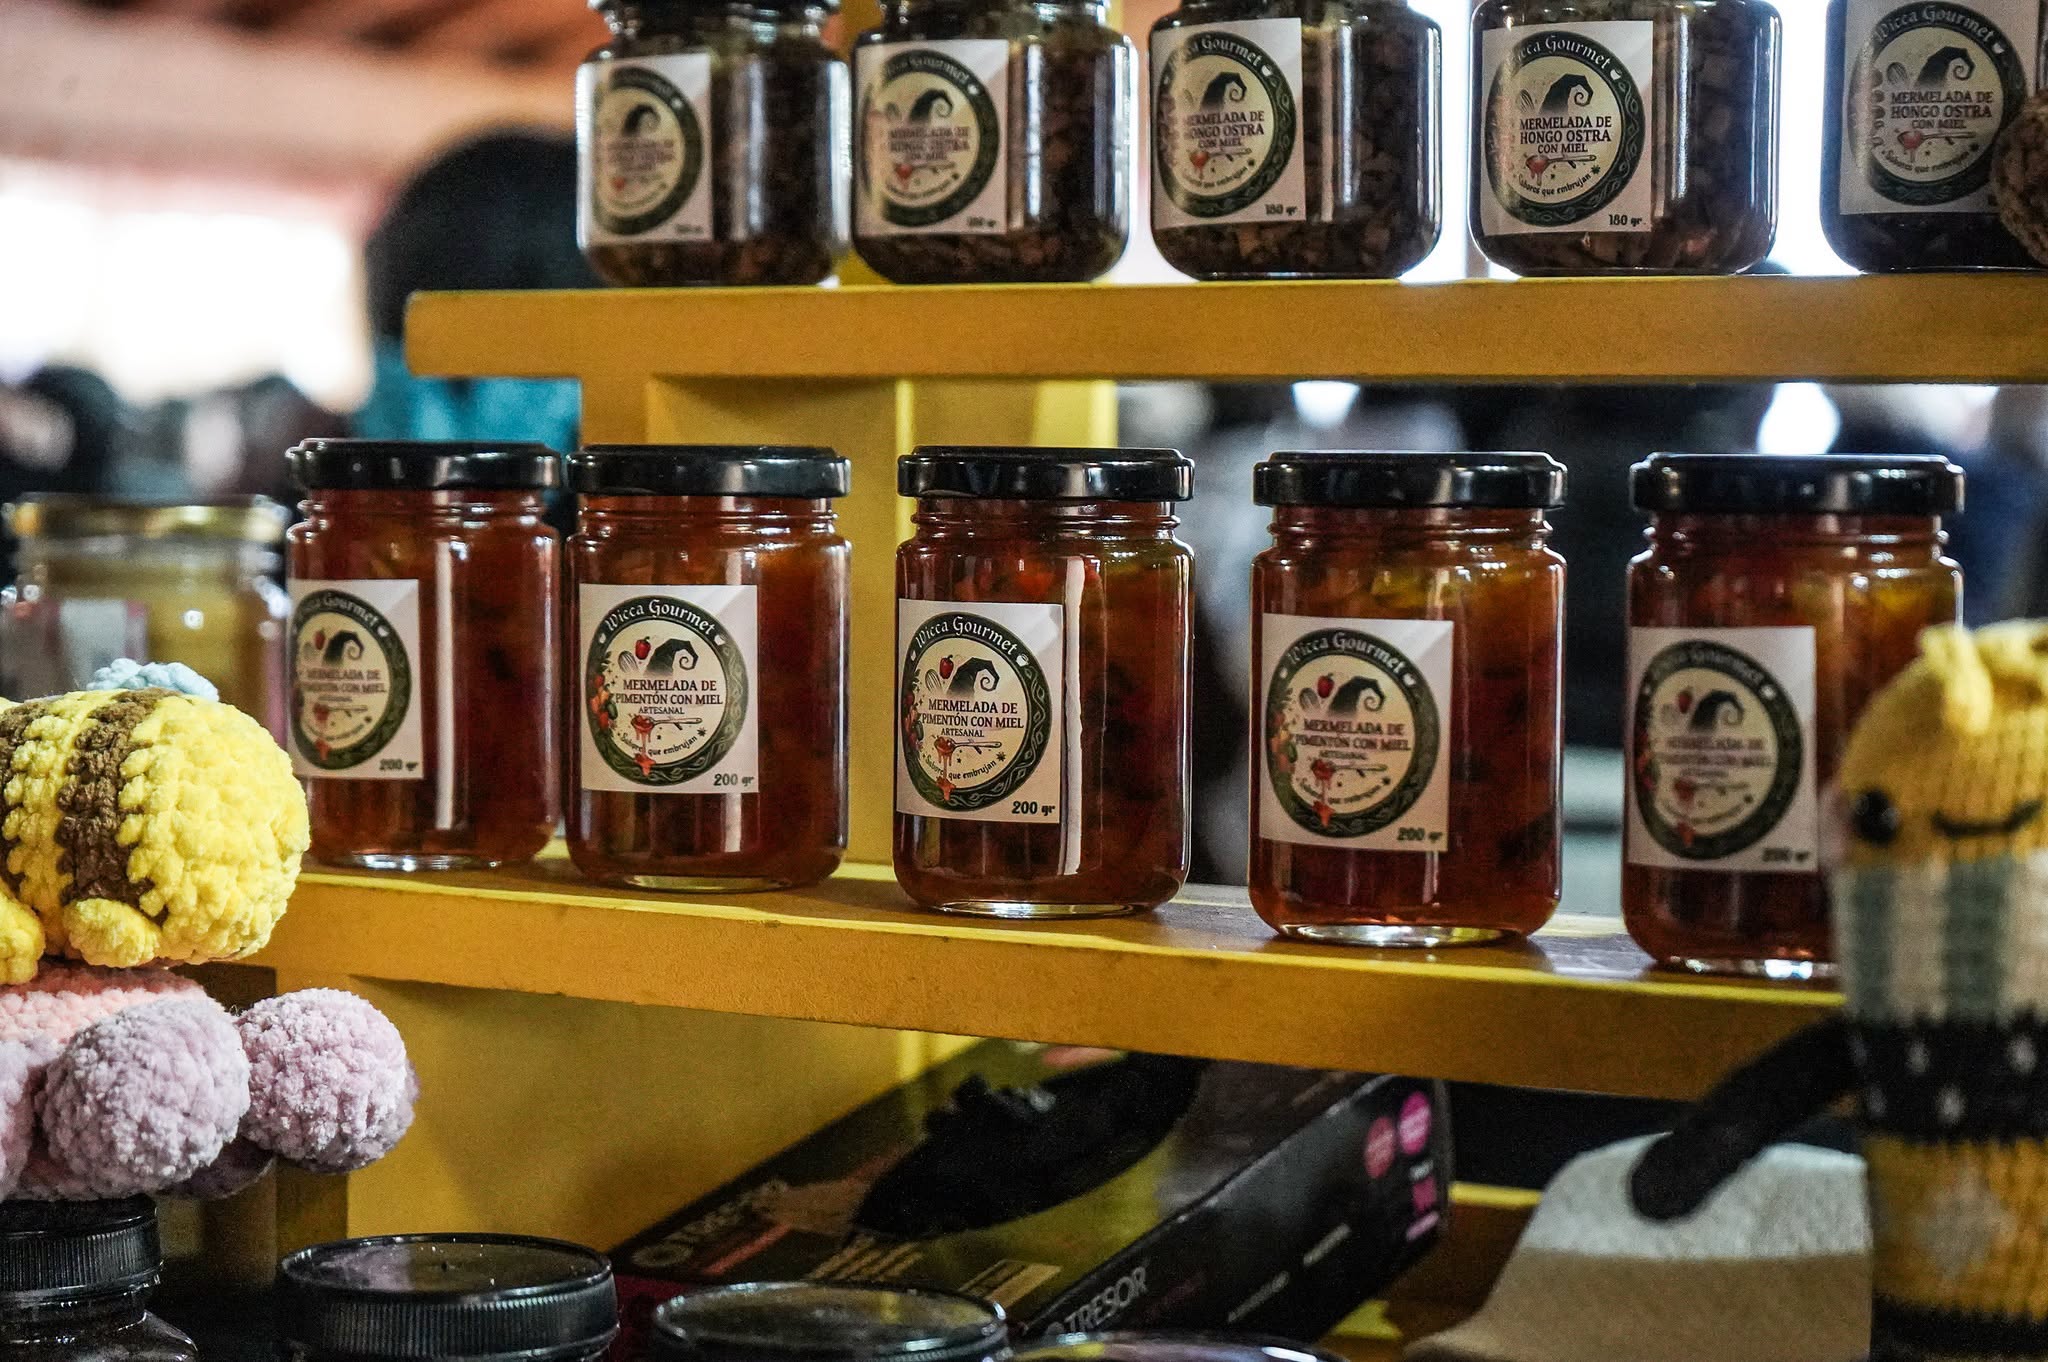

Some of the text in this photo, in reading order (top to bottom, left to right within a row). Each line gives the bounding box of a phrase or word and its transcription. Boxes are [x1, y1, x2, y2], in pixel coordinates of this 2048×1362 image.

[1873, 5, 1995, 43] Wicca Gourmet
[1201, 34, 1263, 67] Gourmet
[1545, 34, 1612, 69] Gourmet
[1891, 91, 1993, 104] MERMELADA DE
[1250, 111, 1265, 122] DE
[1891, 105, 1992, 118] HONGO OSTRA
[1222, 124, 1264, 138] OSTRA
[1520, 116, 1612, 131] MERMELADA DE
[1912, 119, 1967, 129] CON MIEL
[1520, 130, 1611, 145] HONGO OSTRA
[1537, 143, 1588, 154] CON MIEL
[1542, 188, 1555, 197] que
[1556, 173, 1592, 194] embrujan
[1609, 214, 1627, 226] 180
[605, 599, 715, 635] Wicca Gourmet
[915, 616, 1017, 656] Wicca Gourmet
[1288, 632, 1405, 672] Wicca Gourmet
[623, 680, 717, 691] MERMELADA DE
[615, 691, 723, 705] PIMENTÓN CON MIEL
[638, 706, 685, 715] ARTESANAL
[928, 698, 1018, 714] MERMELADA DE
[921, 712, 1024, 729] PIMENTÓN CON MIEL
[1303, 719, 1404, 735] MERMELADA DE
[941, 728, 984, 737] ARTESANAL
[620, 732, 697, 757] Sabore que embrujan
[1353, 737, 1376, 748] CON
[1381, 739, 1411, 751] MIEL
[925, 755, 997, 781] Sabore que embrujan
[713, 773, 754, 787] 200 gr
[1011, 801, 1055, 816] 200 gr
[1064, 1266, 1148, 1332] TRESOR
